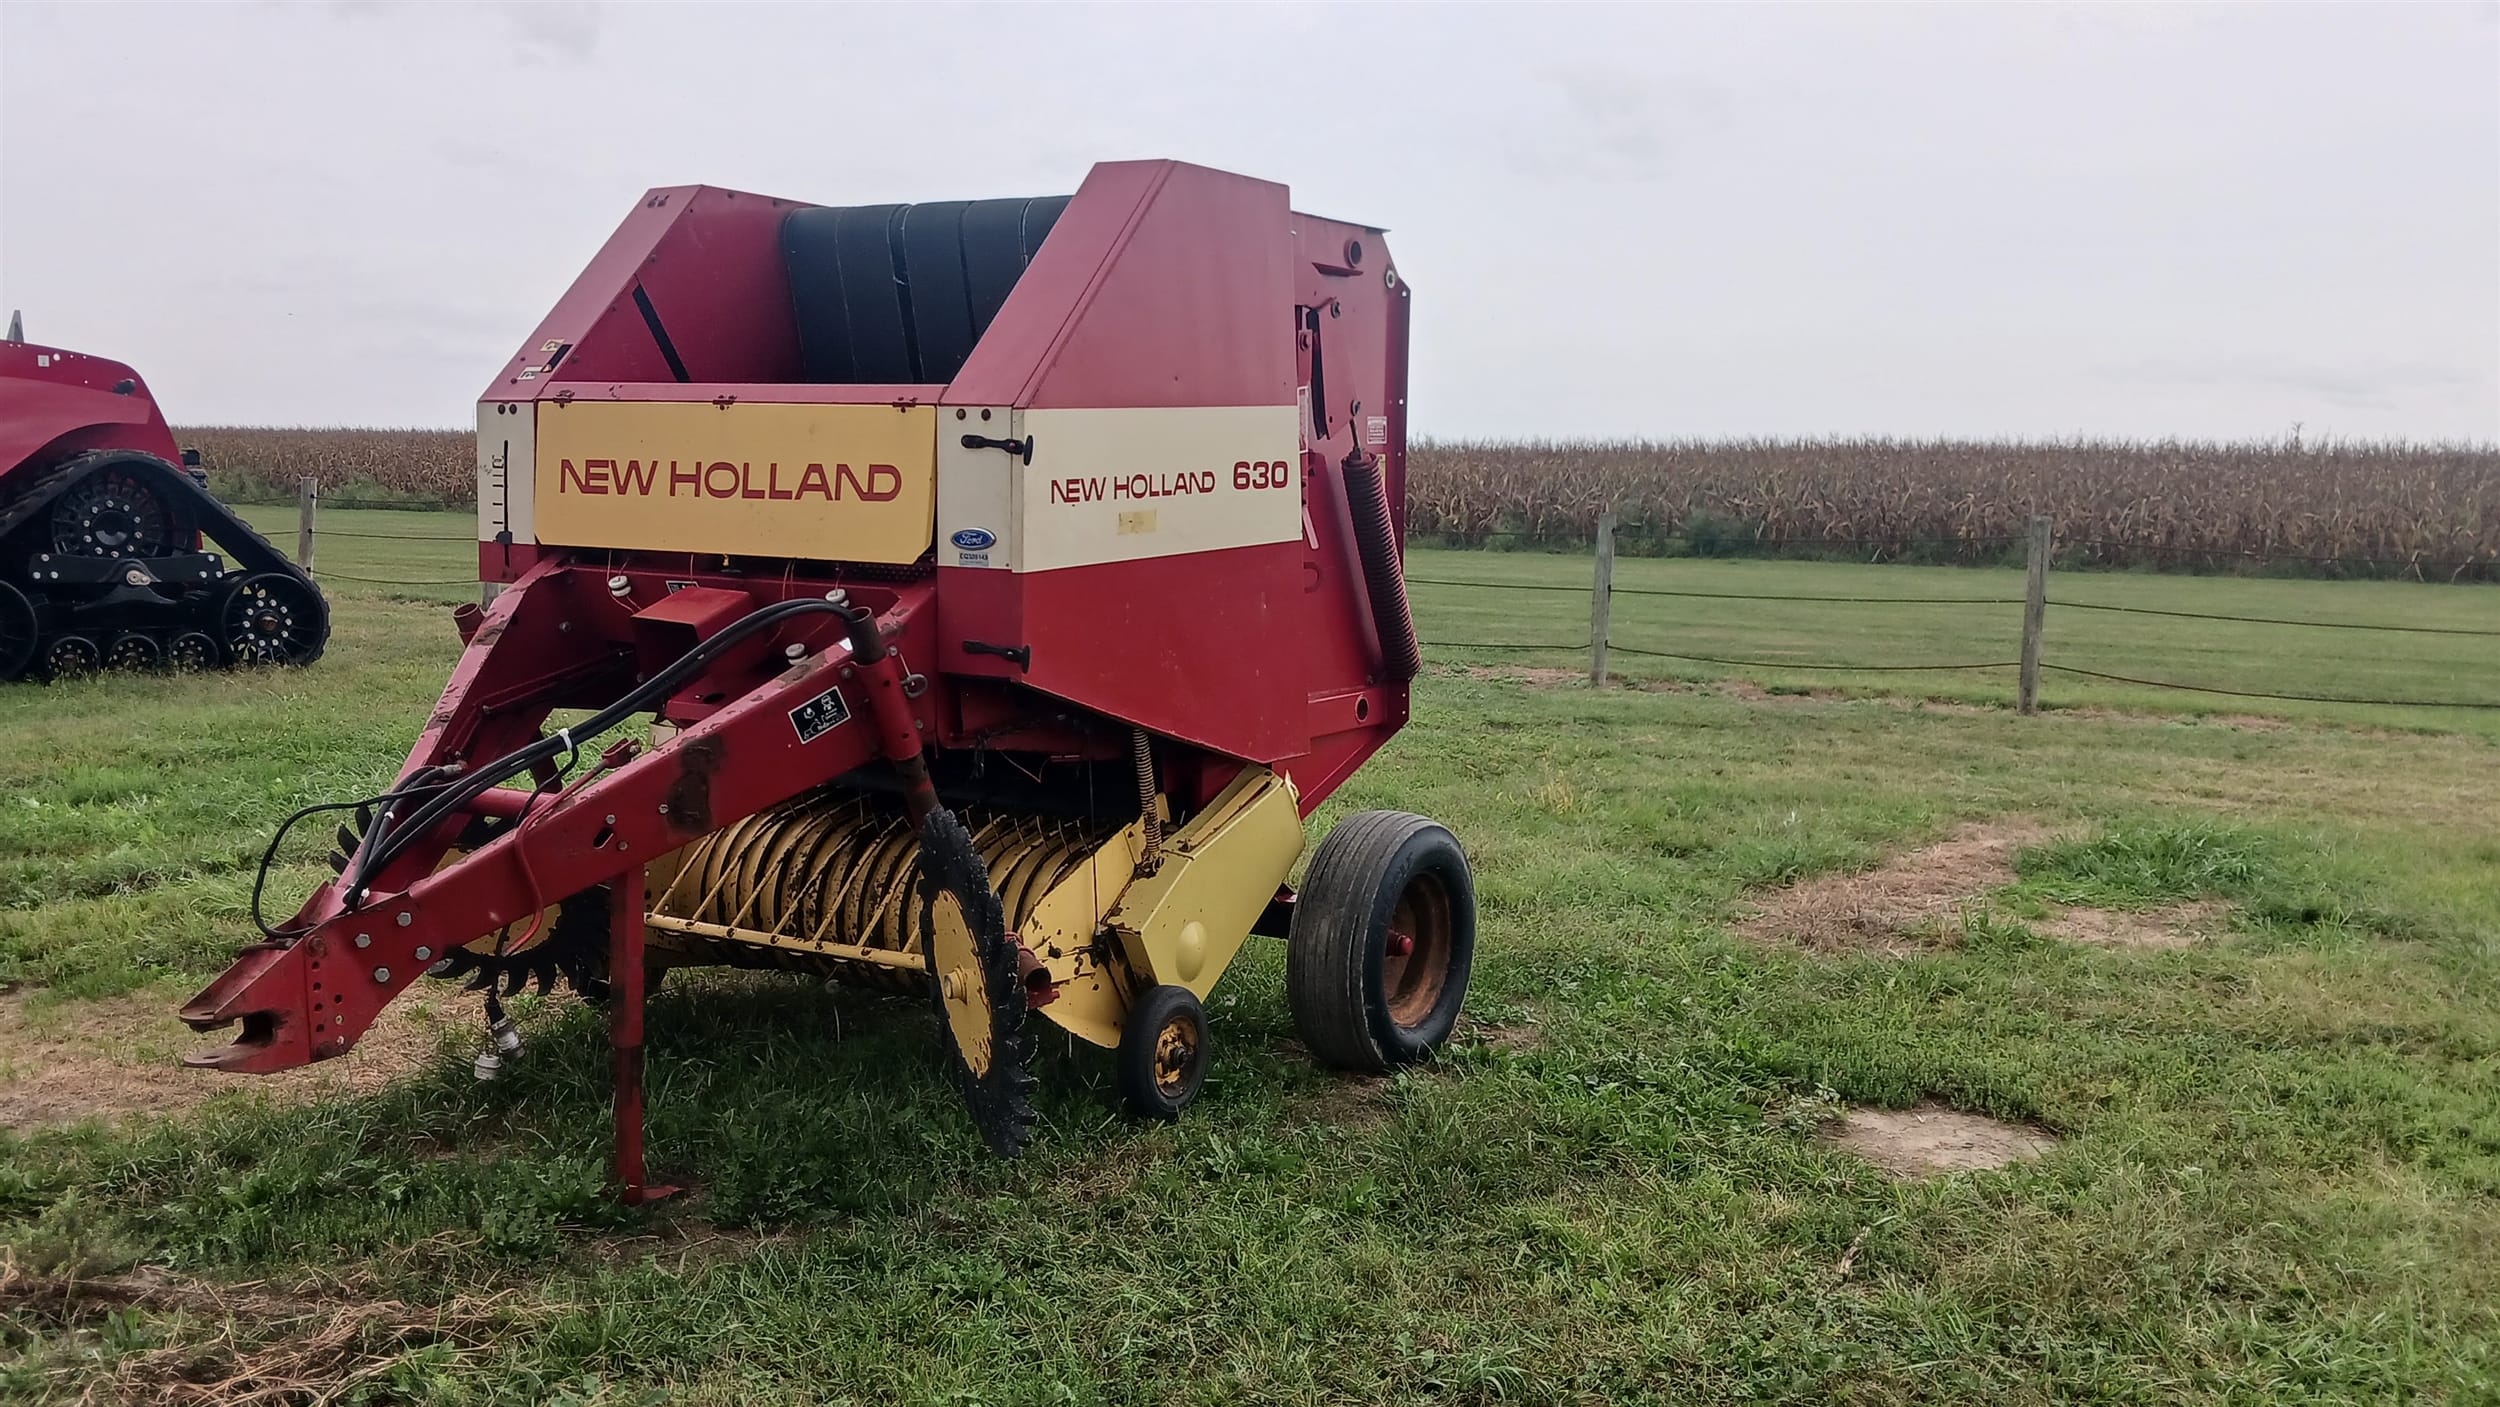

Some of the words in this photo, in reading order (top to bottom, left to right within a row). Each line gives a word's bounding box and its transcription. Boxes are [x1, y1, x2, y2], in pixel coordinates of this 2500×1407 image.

[560, 459, 659, 496] NEW
[669, 460, 903, 502] HOLLAND
[1051, 477, 1106, 504] NEW
[1113, 471, 1216, 500] HOLLAND
[1232, 460, 1289, 490] 630
